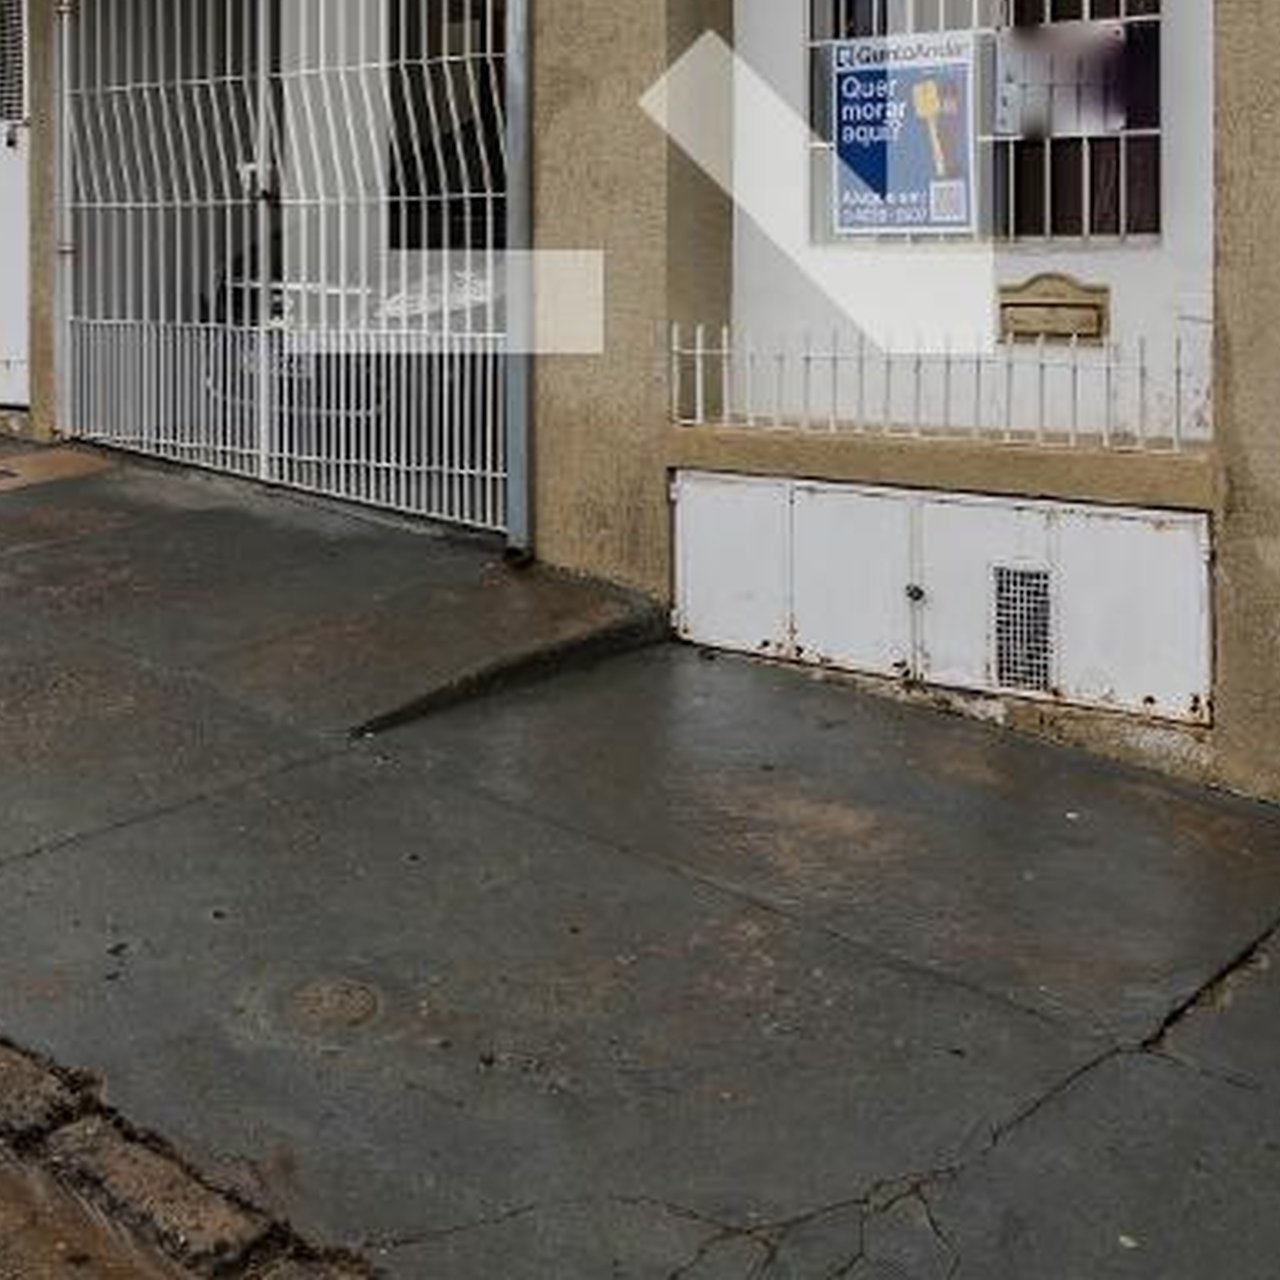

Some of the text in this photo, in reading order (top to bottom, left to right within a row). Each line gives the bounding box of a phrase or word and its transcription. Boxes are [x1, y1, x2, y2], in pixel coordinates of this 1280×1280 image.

[841, 75, 898, 100] Quer
[841, 100, 906, 121] morar
[841, 120, 902, 147] aqui?
